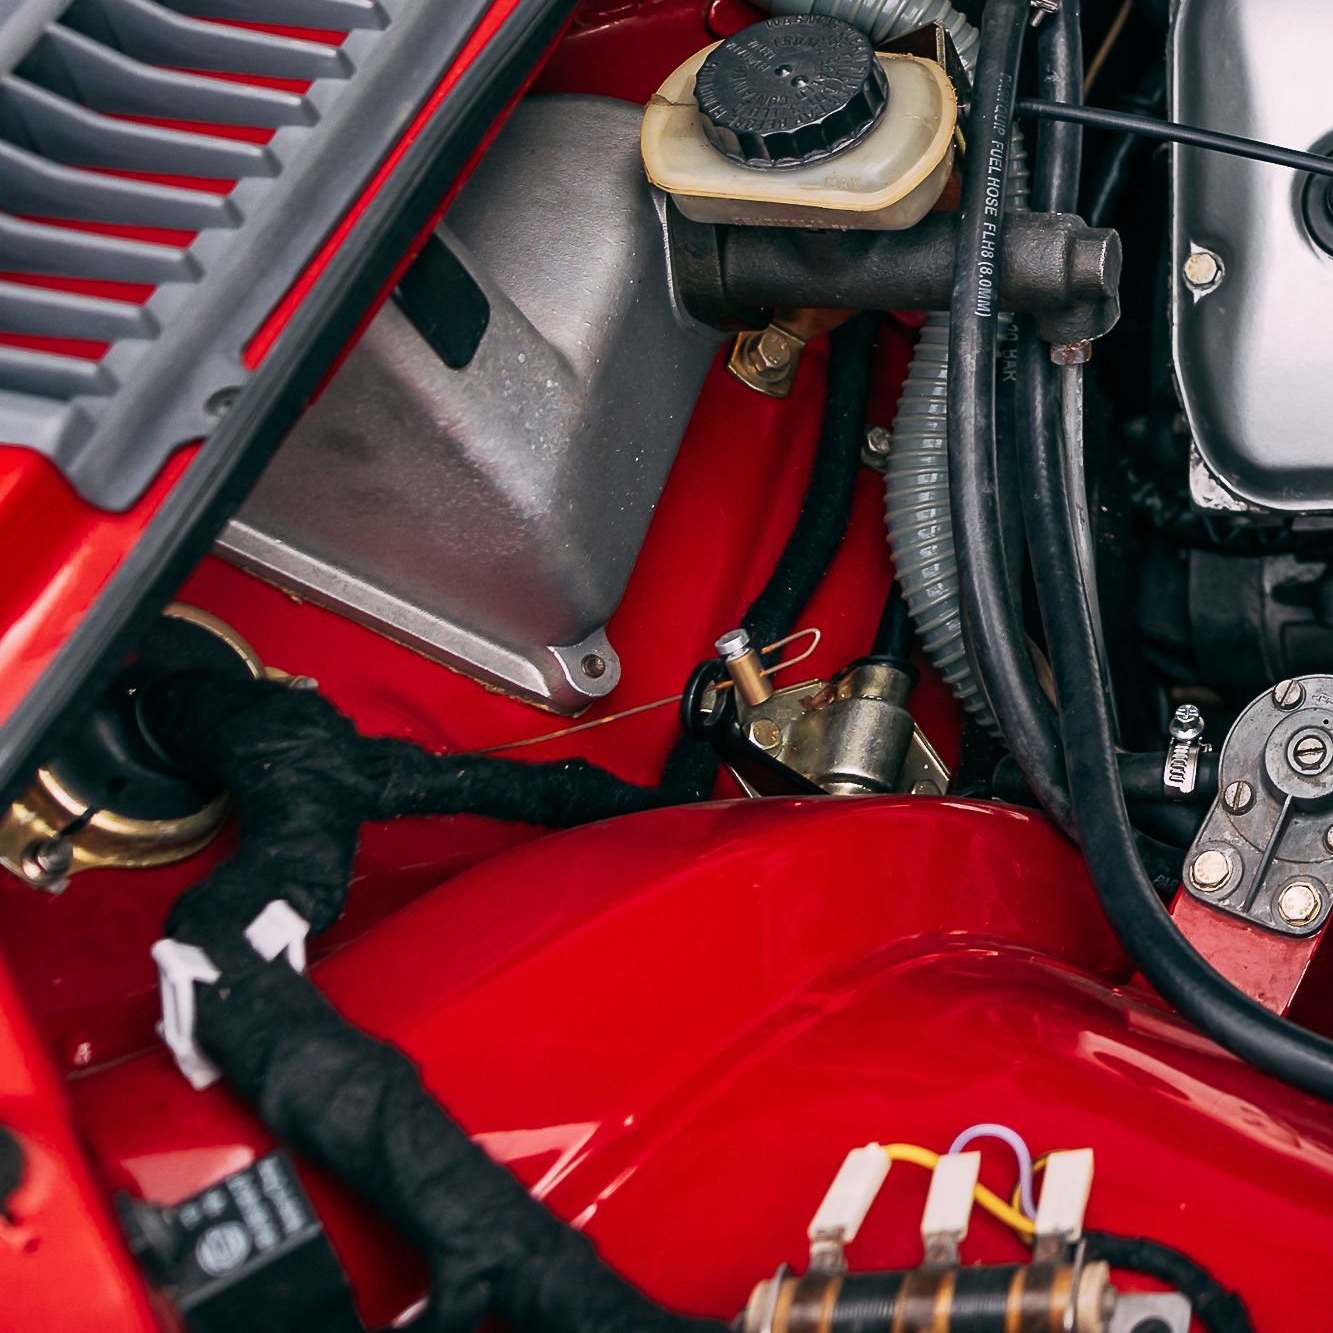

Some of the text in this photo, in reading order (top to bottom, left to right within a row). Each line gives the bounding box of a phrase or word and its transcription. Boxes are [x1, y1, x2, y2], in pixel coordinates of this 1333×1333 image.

[989, 140, 1004, 174] FUEL
[984, 174, 1001, 216] HOSE
[980, 221, 997, 259] FLH8
[975, 261, 994, 318] (8.0MM)
